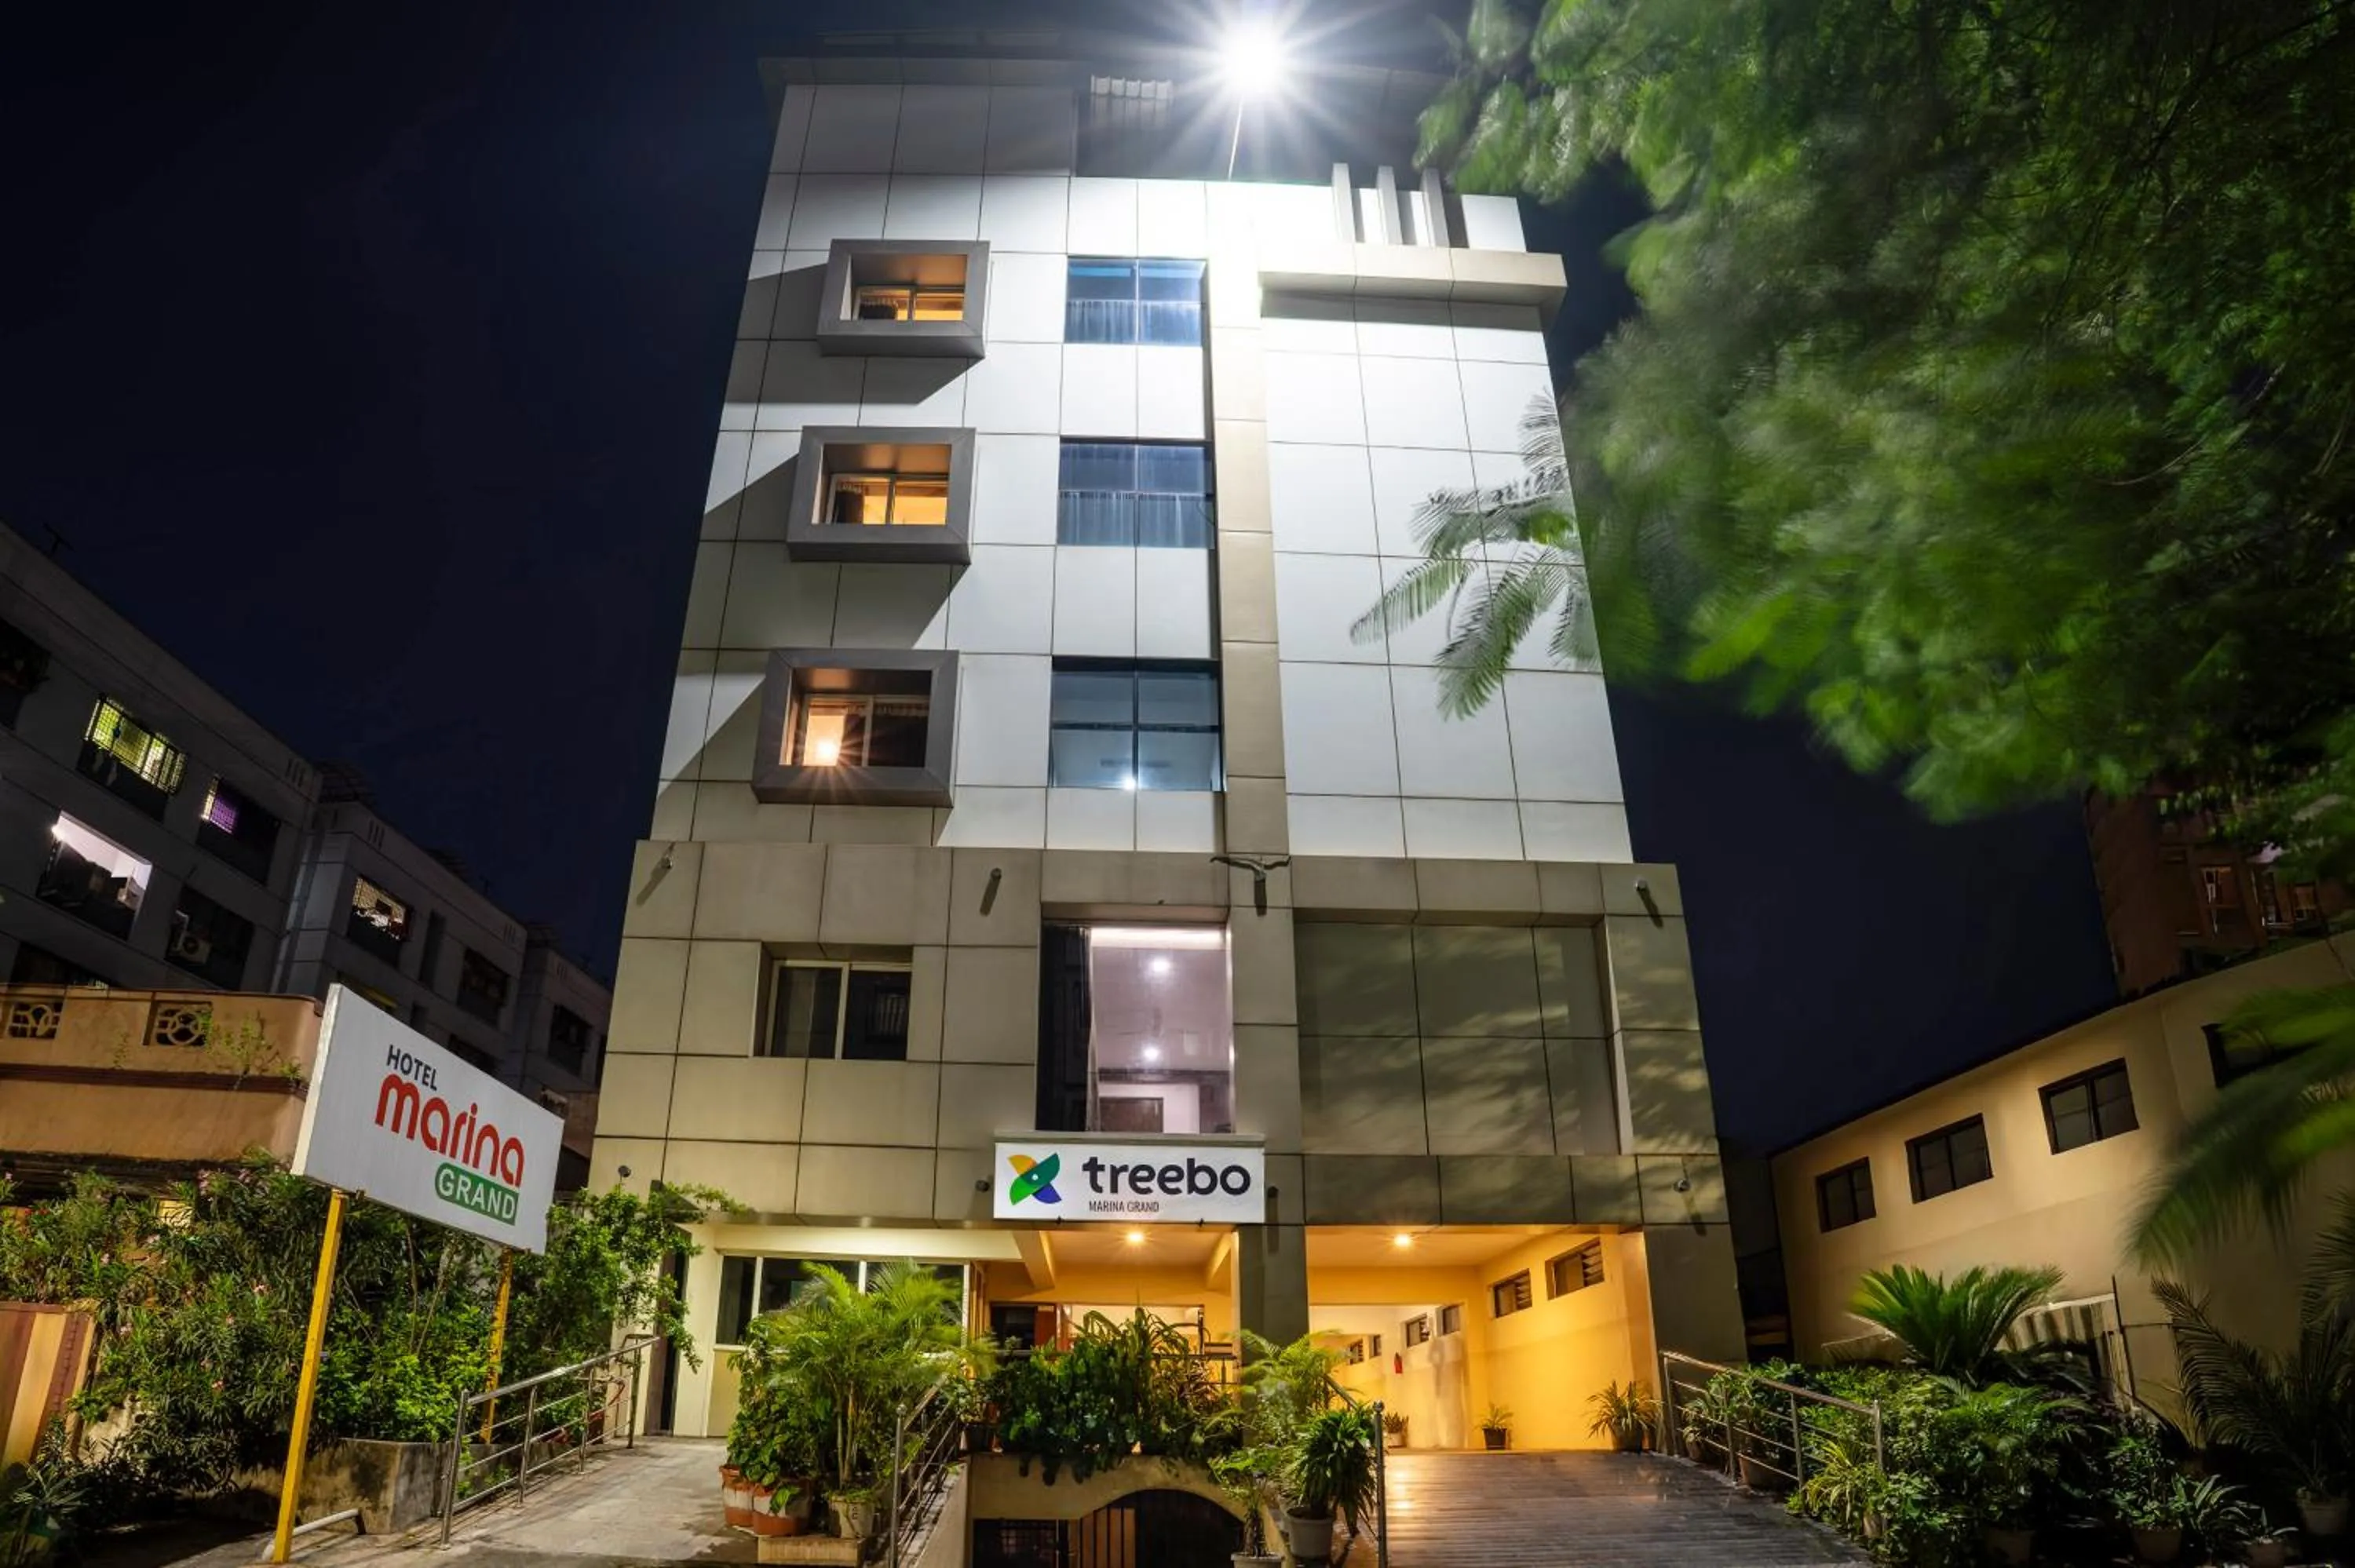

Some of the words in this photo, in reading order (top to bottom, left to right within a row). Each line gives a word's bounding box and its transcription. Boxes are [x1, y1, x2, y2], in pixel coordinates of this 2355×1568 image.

[386, 1045, 437, 1092] HOTEL
[374, 1073, 524, 1187] marina
[438, 1167, 516, 1220] GRAND
[1082, 1157, 1251, 1195] treebo
[1089, 1200, 1124, 1212] MARINA
[1127, 1201, 1159, 1212] GRAND
